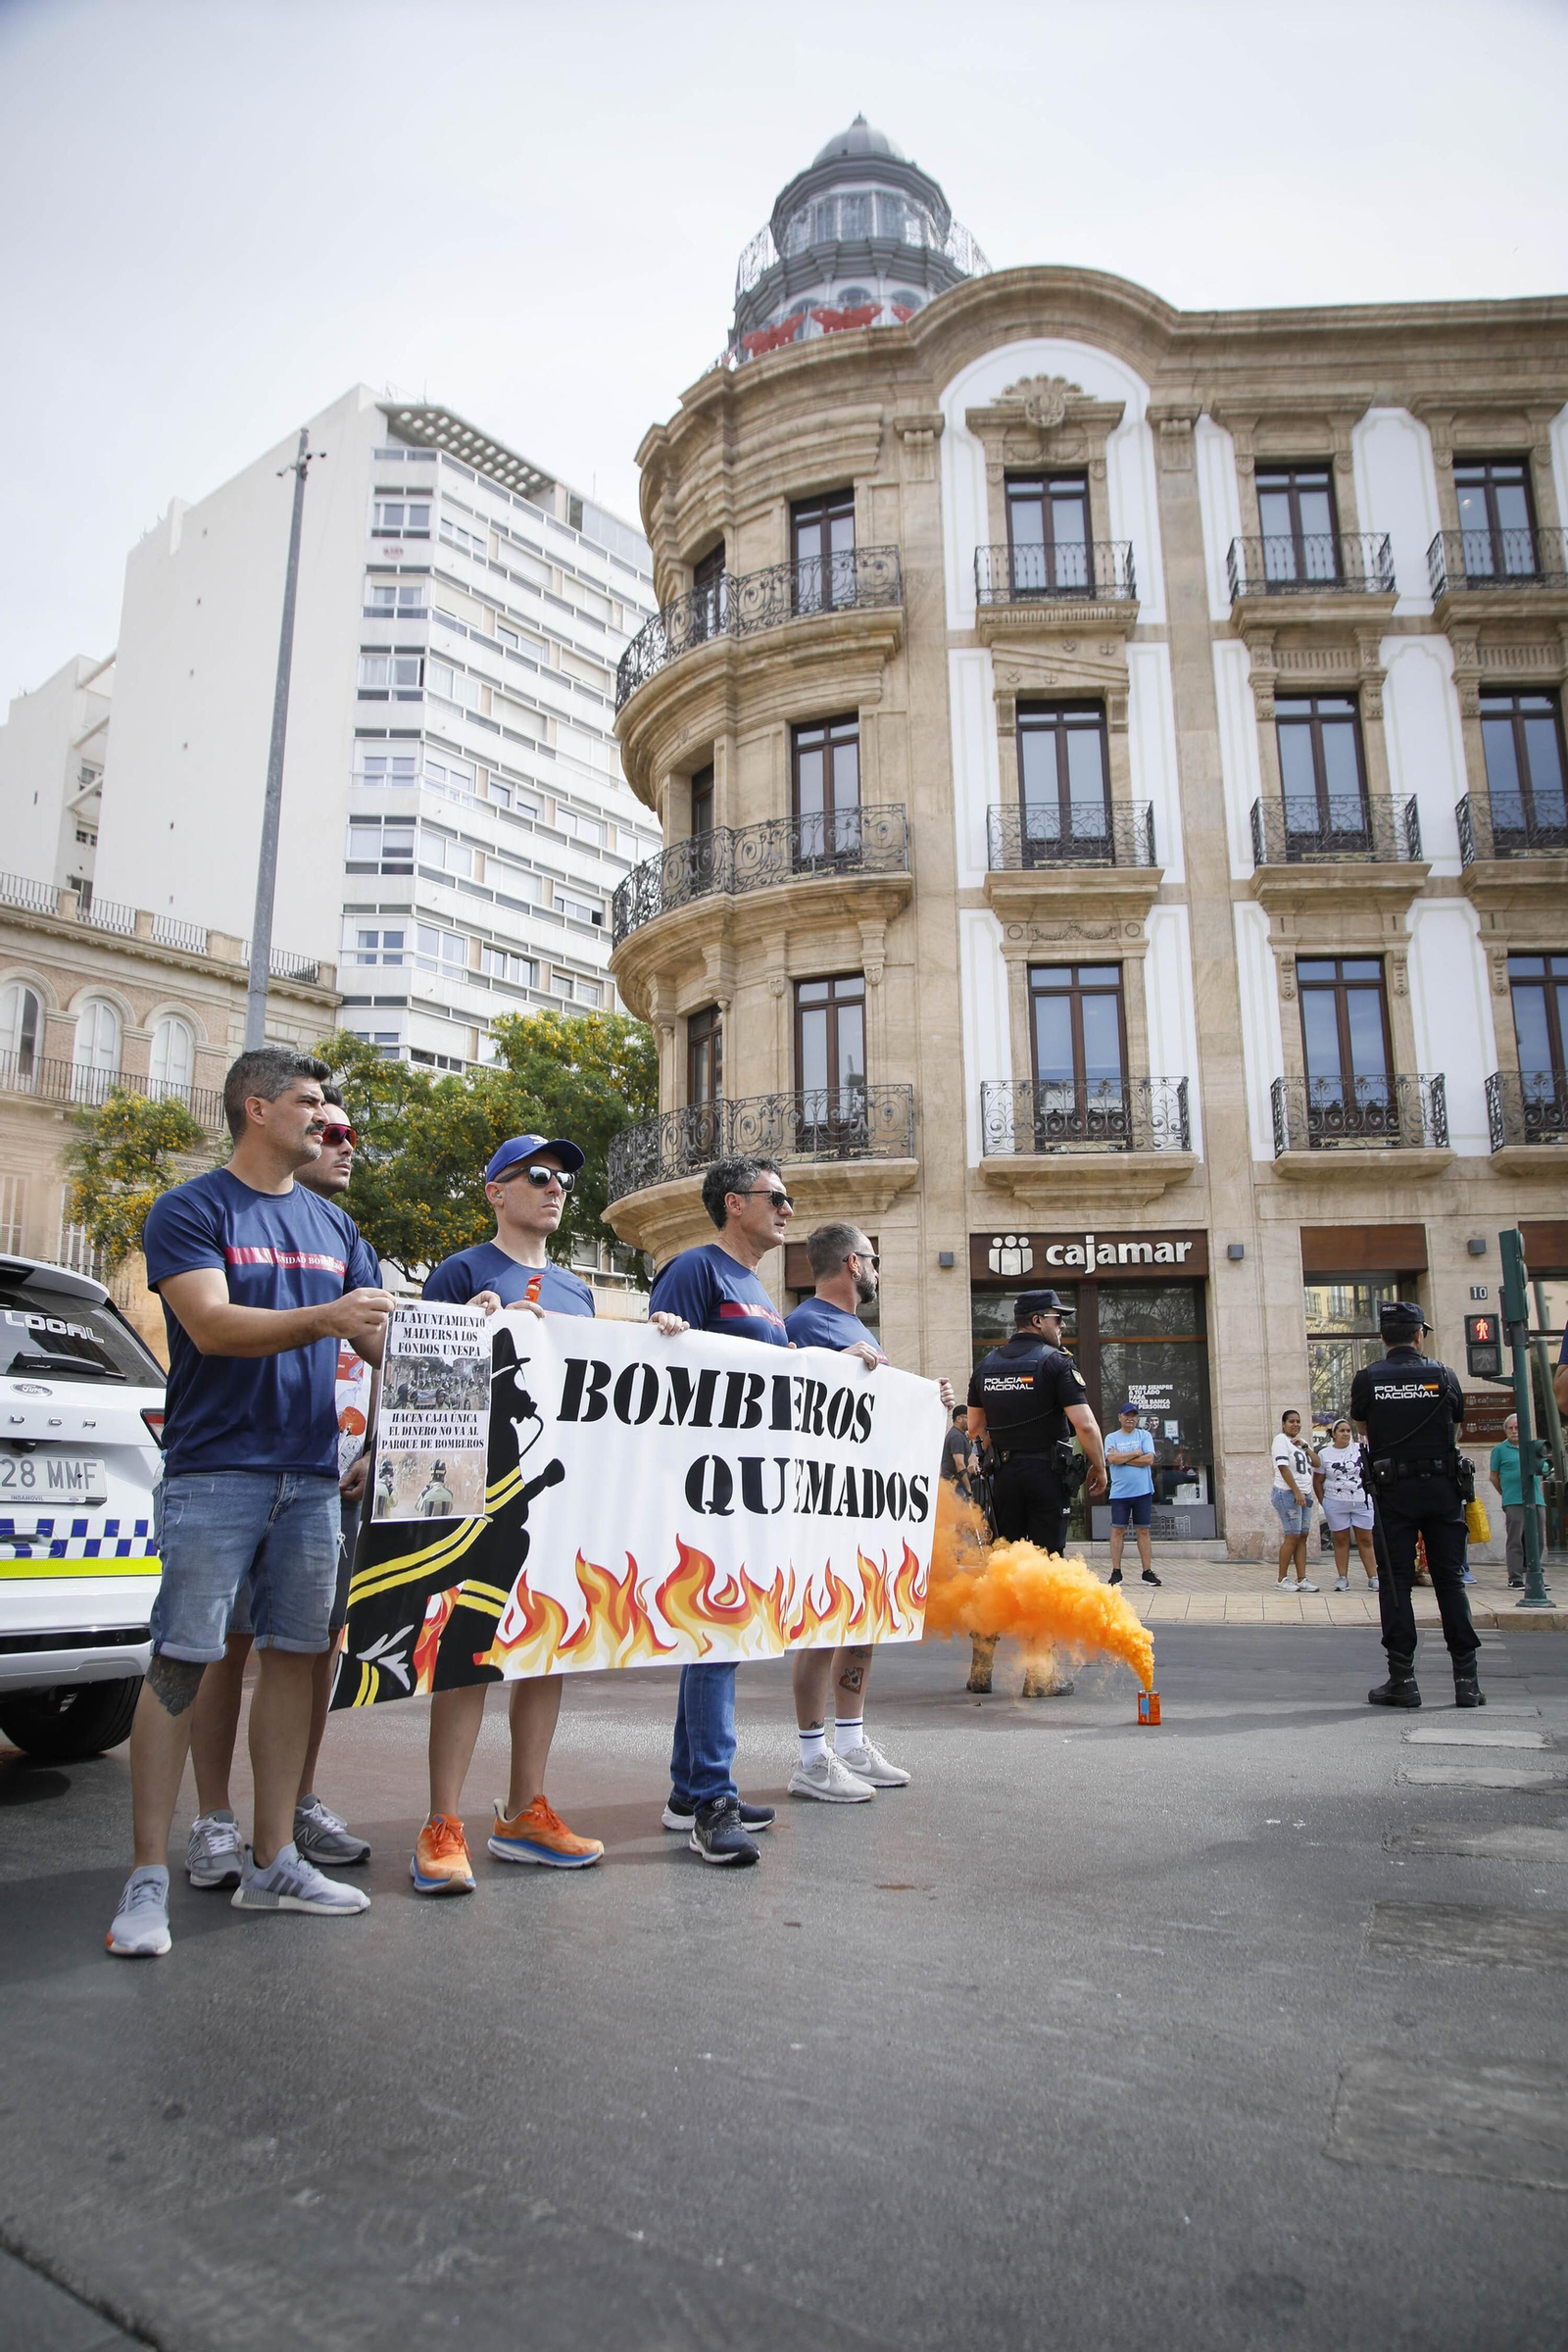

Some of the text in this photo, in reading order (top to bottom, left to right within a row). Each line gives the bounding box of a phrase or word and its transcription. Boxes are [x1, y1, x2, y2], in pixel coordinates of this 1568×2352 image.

[1045, 1235, 1193, 1274] cajamar
[1472, 1287, 1488, 1298] 10
[394, 1311, 486, 1328] EL AYUNTAMIENTO
[4, 1310, 105, 1344] LOCAL
[403, 1327, 478, 1343] MALVERSA LOS
[398, 1342, 481, 1357] FONDOS UNESPA
[983, 1383, 1034, 1392] NACIONAL
[1374, 1384, 1427, 1393] POLICIA
[556, 1357, 875, 1445] BOMBEROS
[1375, 1391, 1440, 1400] NACIONAL
[392, 1411, 477, 1423] HACEN CAJA ÚNICA
[388, 1426, 479, 1437] EL DINERO NO VA AL
[381, 1439, 485, 1449] PARQUE DE BOMBEROS
[47, 1460, 97, 1490] MMF
